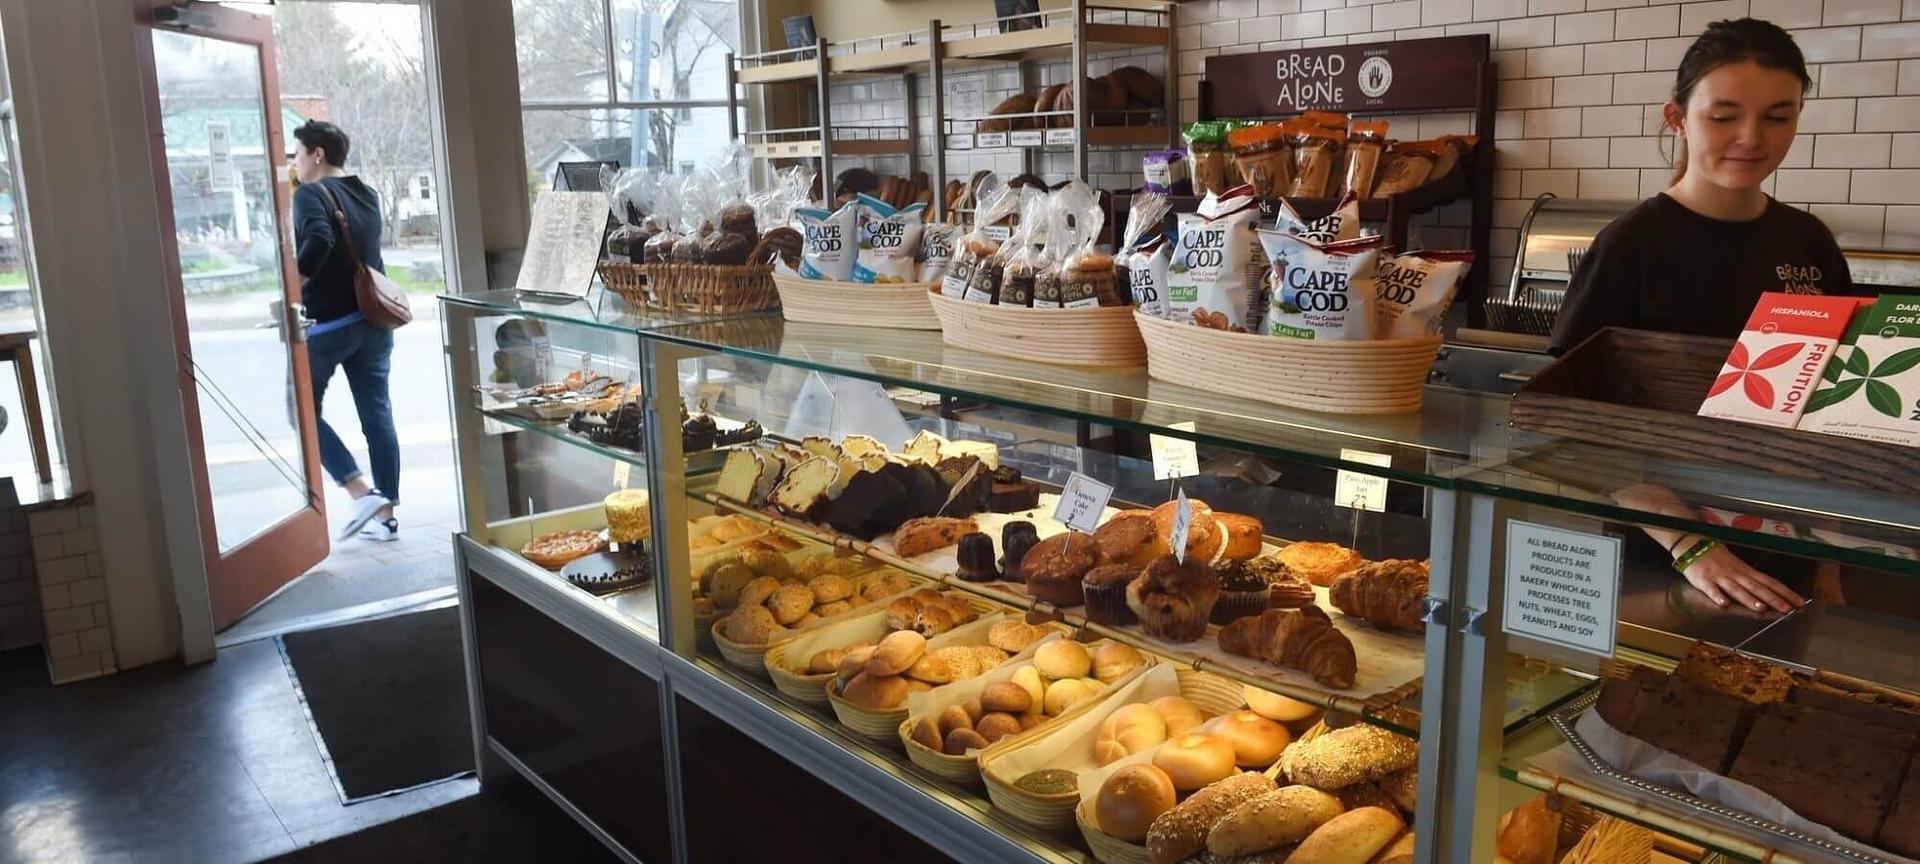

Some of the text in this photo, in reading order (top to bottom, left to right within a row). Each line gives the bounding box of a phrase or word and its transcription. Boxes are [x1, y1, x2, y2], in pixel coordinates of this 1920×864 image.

[1277, 54, 1345, 79] BREAD
[1277, 77, 1344, 111] ALONE
[808, 225, 842, 241] CAPE
[866, 222, 906, 238] CAPE
[1183, 230, 1226, 250] CAPE
[870, 235, 903, 249] COD
[1185, 248, 1225, 270] COD
[1288, 267, 1348, 292] CAPE
[1380, 262, 1428, 288] CAPE
[1776, 263, 1823, 281] BREAD
[1295, 290, 1350, 312] COD
[1377, 279, 1416, 305] COD
[1770, 306, 1830, 320] HISPANIOLA
[1896, 303, 1920, 312] DAR
[1886, 315, 1916, 324] FLOR
[1780, 343, 1828, 414] FRUITION
[1074, 499, 1089, 510] Cake
[1527, 537, 1597, 557] ALL BREAD ALONE
[1531, 551, 1591, 569] PRODUCTS ARE
[1530, 564, 1574, 579] PRODUCED
[1574, 573, 1584, 581] IN
[1520, 575, 1601, 599] BAKERY WHICH ALSO
[1528, 589, 1591, 610] PROCESSES TREE
[1522, 614, 1595, 638] PEANUTS AND SOY
[1543, 606, 1574, 620] WHEAT,
[1575, 613, 1600, 626] EGGS,
